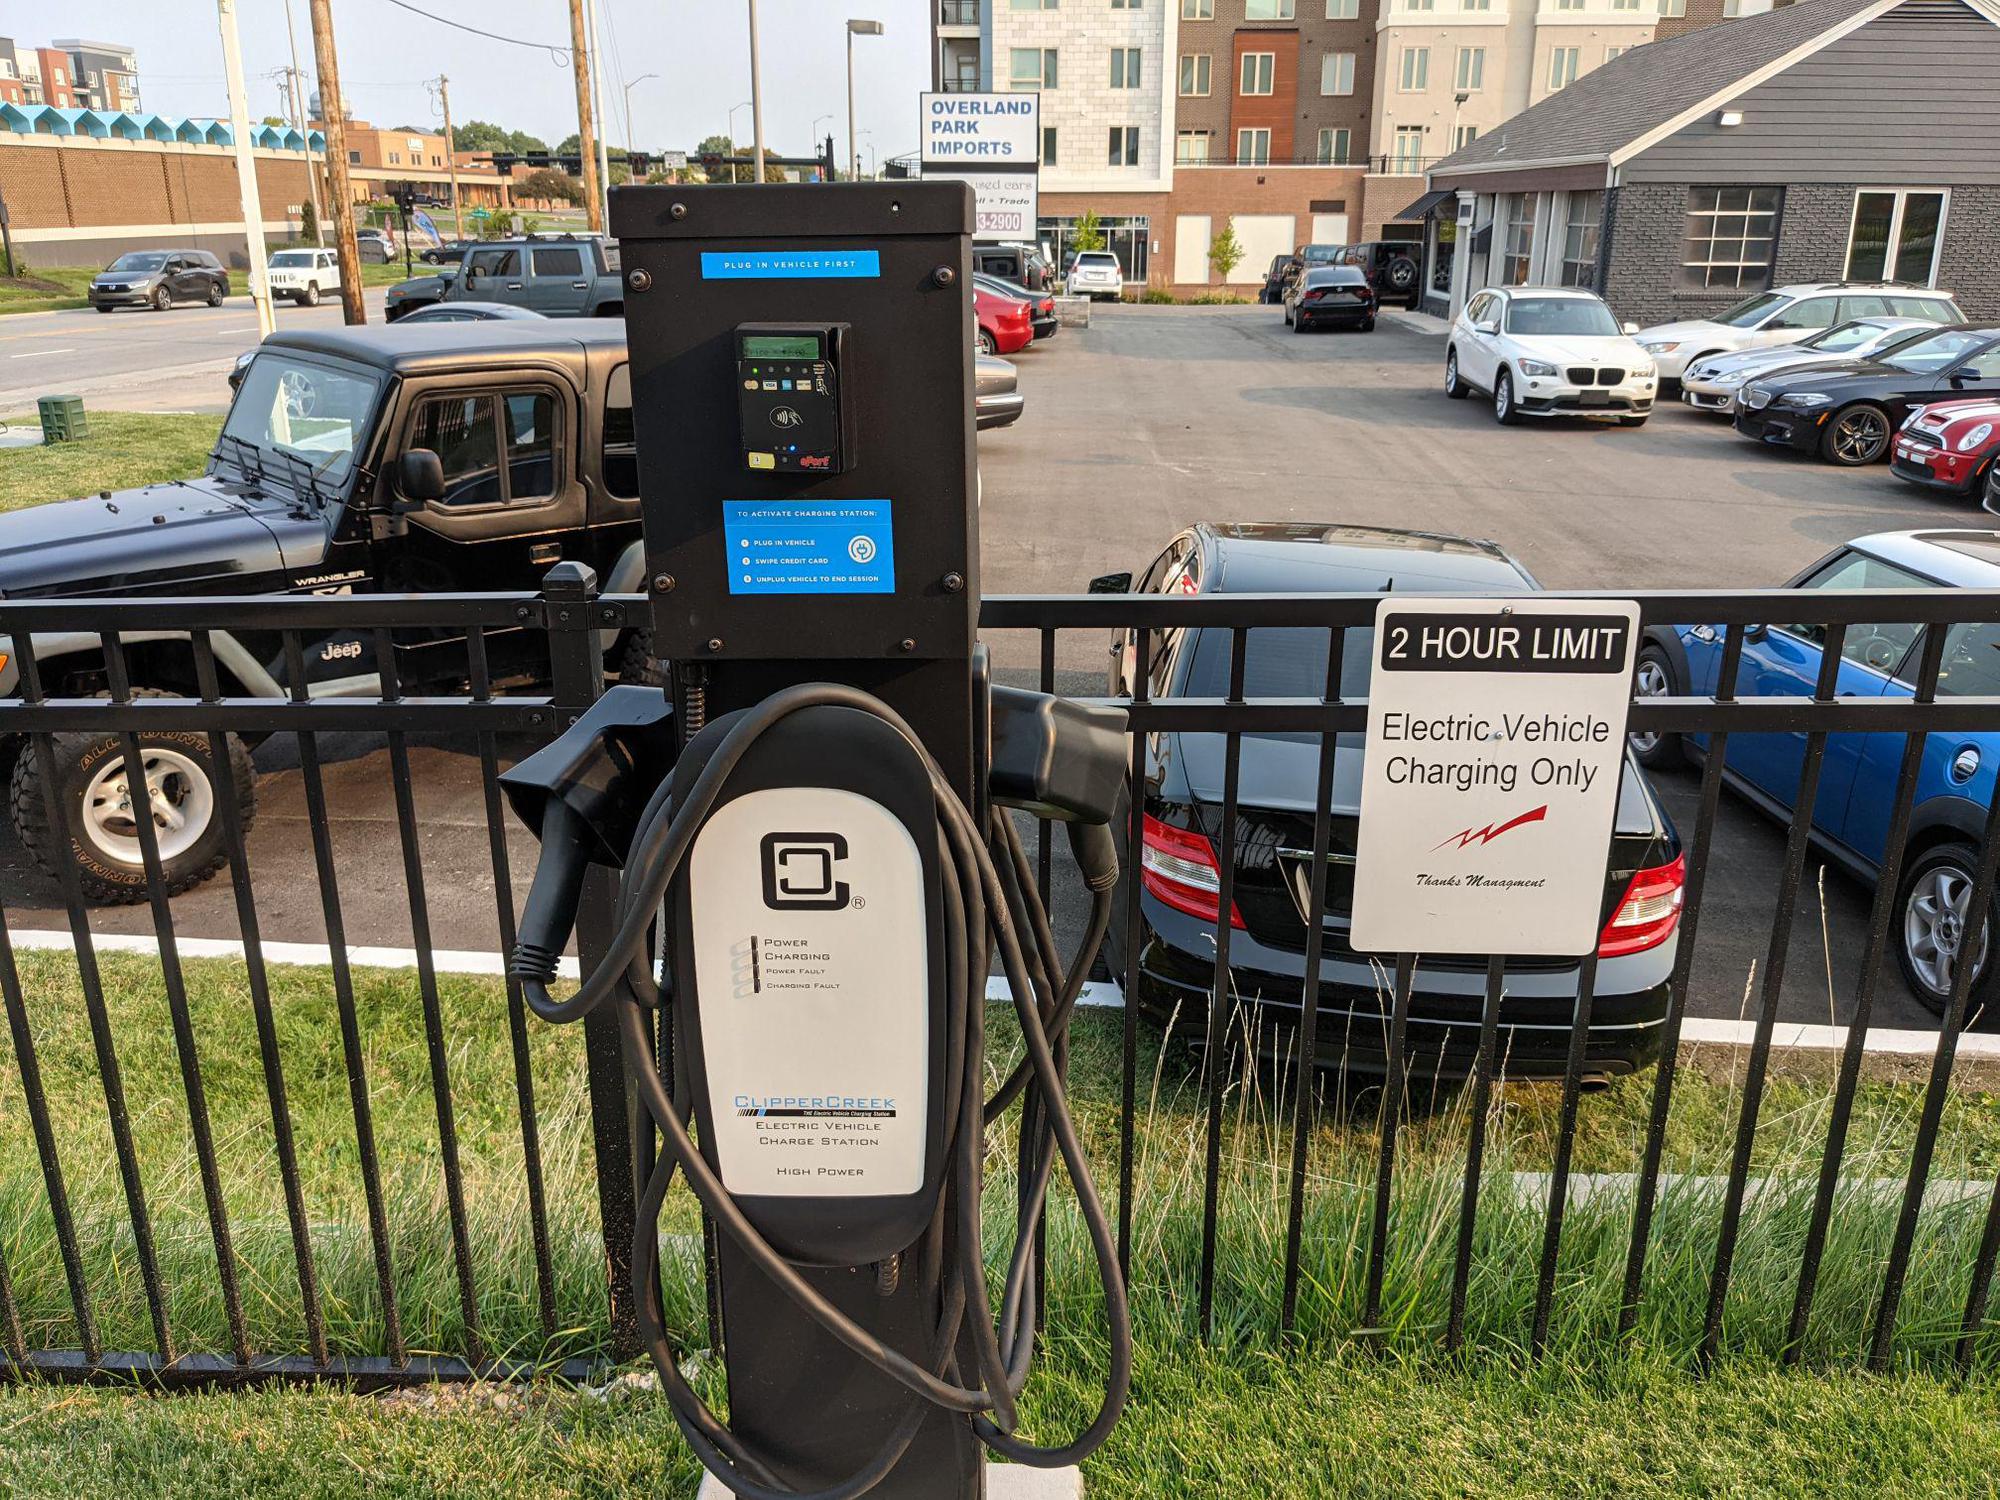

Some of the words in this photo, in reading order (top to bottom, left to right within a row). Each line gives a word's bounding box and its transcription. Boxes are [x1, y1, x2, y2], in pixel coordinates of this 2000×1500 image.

[931, 101, 1032, 115] OVERLAND
[931, 120, 979, 134] PARK
[931, 141, 1013, 155] IMPORTS
[999, 197, 1030, 205] Trade
[825, 260, 856, 268] FIRST
[295, 570, 365, 586] WRANGLER
[321, 641, 362, 660] Jeep
[1389, 627, 1409, 659] 2
[1421, 627, 1520, 659] HOUR
[1532, 627, 1622, 660] LIMIT
[1382, 713, 1490, 741] Electric
[1503, 713, 1609, 743] Vehicle
[1386, 756, 1517, 792] Charging
[1531, 757, 1598, 793] Only
[1416, 873, 1461, 887] Thanks
[1465, 874, 1546, 890] Managment
[850, 1110, 872, 1118] Charging
